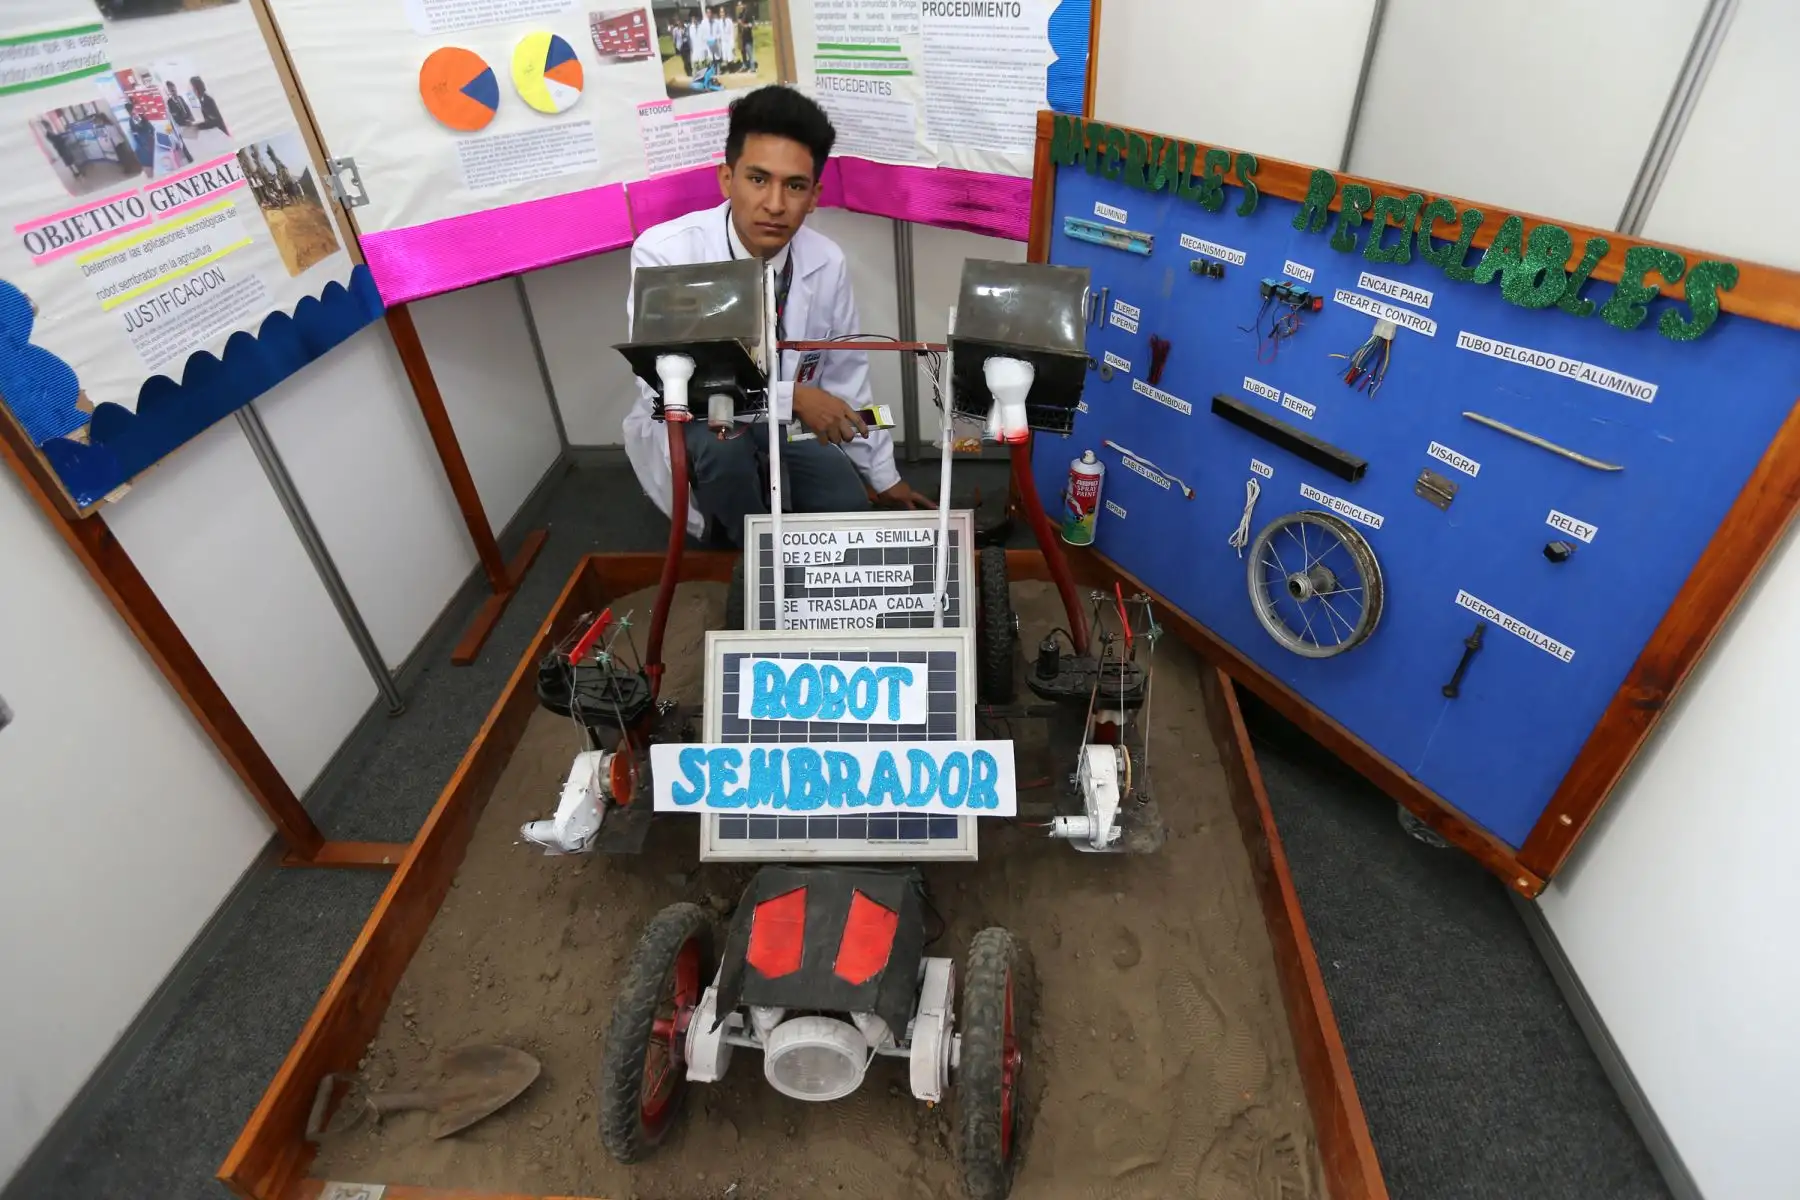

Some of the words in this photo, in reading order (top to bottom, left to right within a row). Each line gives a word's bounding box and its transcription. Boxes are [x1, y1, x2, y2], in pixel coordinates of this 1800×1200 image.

[922, 1, 1021, 18] PROCEDIMIENTO
[815, 76, 892, 96] ANTECEDENTES
[639, 105, 673, 116] METODOS
[1051, 115, 1259, 218] MATERIALES
[23, 196, 145, 255] OBJETIVO
[1096, 205, 1126, 222] ALUMINIO
[81, 252, 128, 277] Determinar
[129, 247, 142, 258] las
[142, 229, 187, 254] aplicaciones
[1181, 237, 1227, 259] MECANISMO
[1228, 251, 1244, 265] DVD
[1292, 169, 1739, 341] RECICLABLES
[96, 282, 118, 300] robot
[119, 265, 158, 291] sembrador
[159, 263, 168, 274] en
[168, 258, 178, 270] la
[178, 244, 212, 266] agricultura
[1285, 263, 1313, 281] SUICH
[124, 266, 226, 333] JUSTIFICACION
[1360, 276, 1399, 296] ENCAJE
[1400, 288, 1430, 307] PARA
[1115, 302, 1139, 317] TUERCA
[1336, 290, 1369, 310] CREAR
[1371, 302, 1383, 315] EL
[1385, 308, 1433, 333] CONTROL
[1116, 317, 1137, 333] PERNO
[1460, 335, 1491, 352] TUBO
[1493, 344, 1556, 370] DELGADO
[1558, 361, 1579, 376] DE
[1579, 368, 1653, 400] ALUMINIO
[1133, 382, 1153, 397] CABLE
[1154, 391, 1191, 414] INDIBIDUAL
[1245, 380, 1265, 395] TUBO
[1266, 390, 1279, 401] DE
[1284, 397, 1314, 418] FIERRO
[1123, 458, 1146, 475] CABLES
[1146, 471, 1170, 488] UNIDOS
[1252, 462, 1270, 477] HILO
[1430, 443, 1476, 475] VISAGRA
[1107, 501, 1126, 517] SPRAY
[1303, 487, 1321, 501] ARO
[1322, 495, 1334, 507] DE
[1334, 500, 1381, 527] BICICLETA
[783, 532, 837, 546] COLOCA
[848, 531, 865, 544] LA
[876, 529, 931, 543] SEMILLA
[1550, 514, 1592, 539] RELEY
[783, 551, 800, 564] DE
[804, 551, 811, 563] 2
[814, 551, 831, 563] EN
[835, 550, 842, 562] 2
[807, 571, 841, 585] TAPA
[844, 570, 861, 584] LA
[865, 570, 912, 583] TIERRA
[784, 600, 798, 612] SE
[808, 598, 877, 612] TRASLADA
[886, 596, 924, 610] CADA
[1459, 593, 1500, 623] TUERCA
[1503, 617, 1573, 661] REGULABLE
[751, 660, 913, 722] ROBOT
[671, 747, 999, 811] SEMBRADOR
